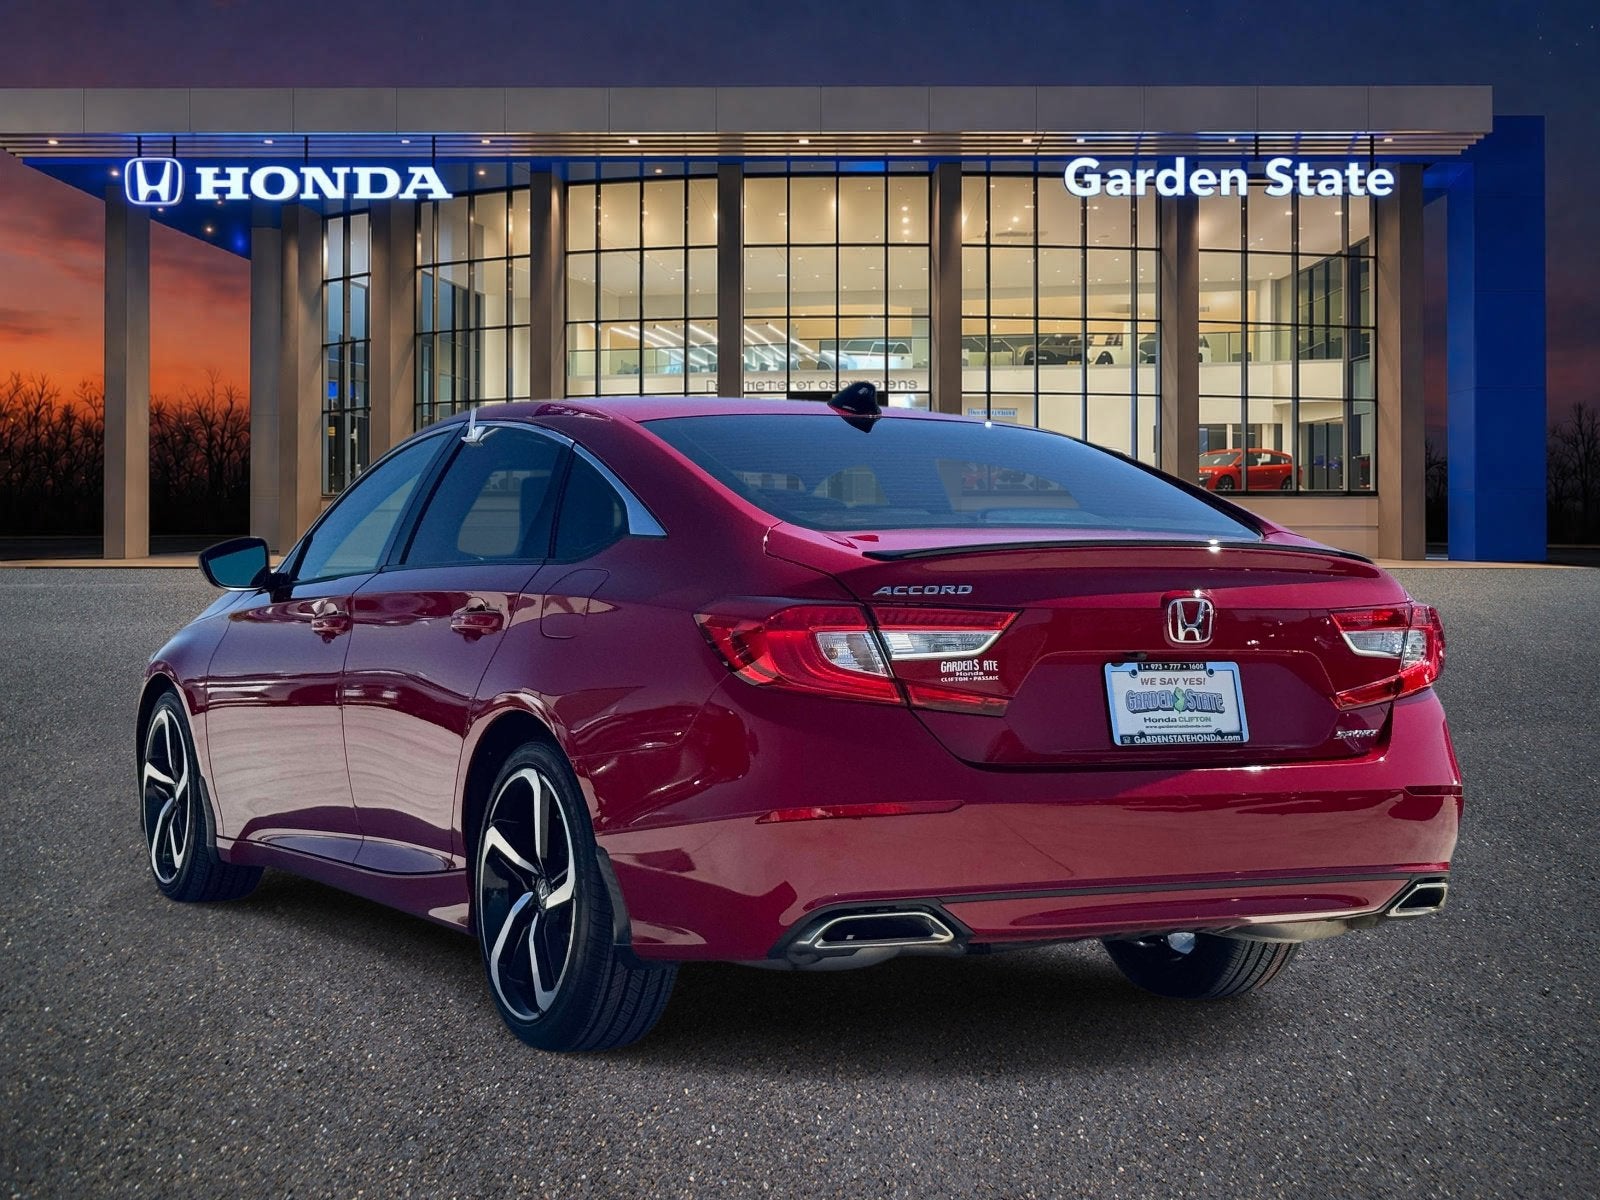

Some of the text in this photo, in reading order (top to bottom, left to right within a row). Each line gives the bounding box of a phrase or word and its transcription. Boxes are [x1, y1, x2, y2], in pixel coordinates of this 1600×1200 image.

[195, 166, 453, 201] HONDA
[1063, 157, 1395, 197] Garden State
[873, 584, 973, 596] ACCORD
[940, 660, 973, 673] GARDEN
[1140, 677, 1206, 686] WE SAY YES!
[1125, 688, 1226, 714] GARDEN STATE
[1133, 733, 1241, 744] GARDENSTATEHONDA.com
